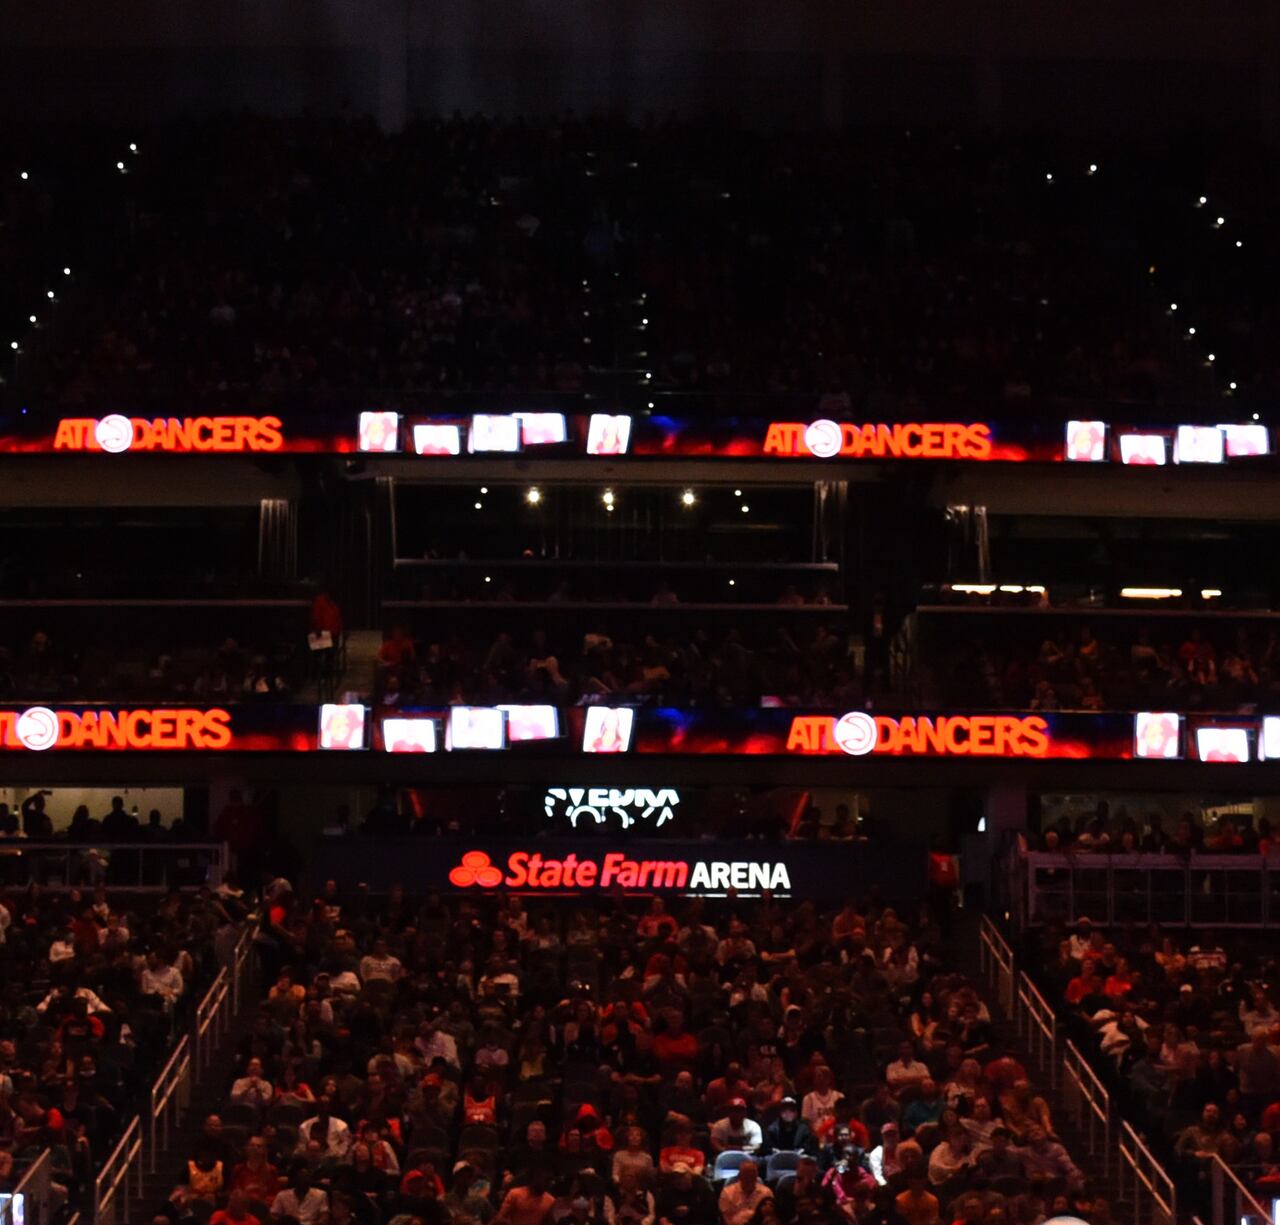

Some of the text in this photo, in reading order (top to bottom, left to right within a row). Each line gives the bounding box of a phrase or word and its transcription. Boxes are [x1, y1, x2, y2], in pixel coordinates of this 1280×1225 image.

[131, 416, 283, 451] DANCERS
[840, 423, 992, 458] DANCERS
[57, 709, 233, 748] DANCERS
[875, 716, 1049, 757] DANCERS
[505, 851, 792, 890] State Farm ARENA
